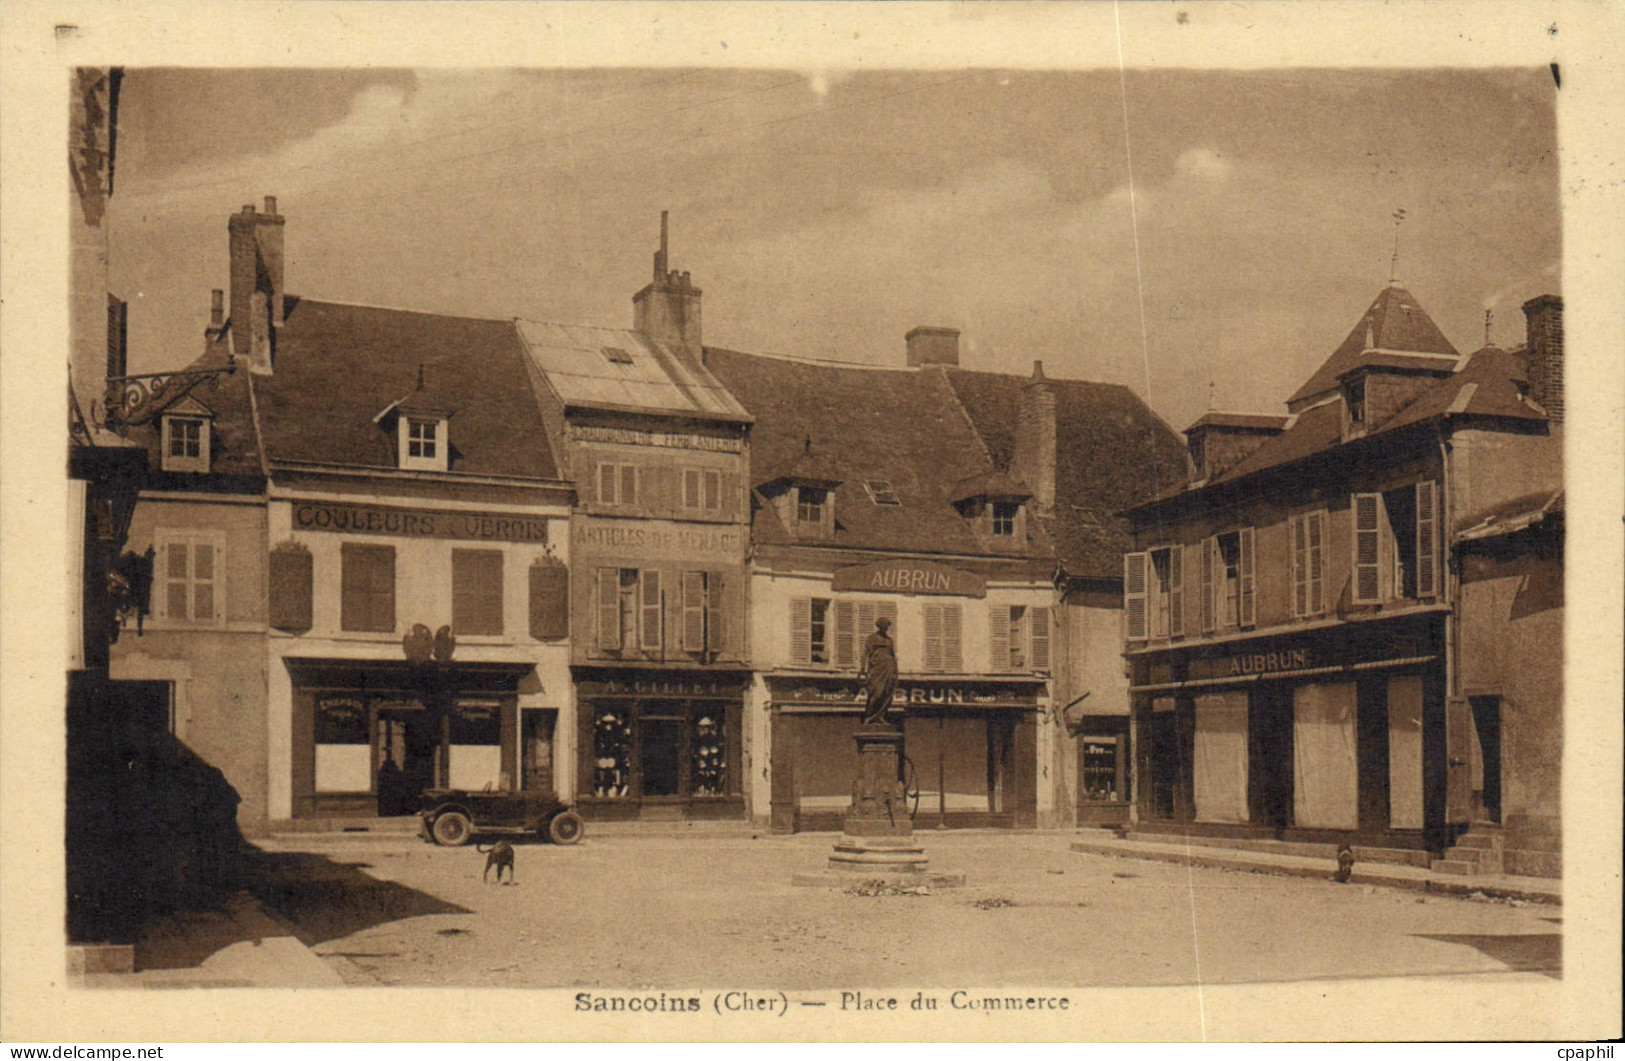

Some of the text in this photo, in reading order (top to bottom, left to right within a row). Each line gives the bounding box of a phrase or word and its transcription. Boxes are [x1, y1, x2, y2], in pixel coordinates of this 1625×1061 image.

[297, 506, 435, 535] COULEURS
[576, 525, 646, 547] ARTICLES
[871, 568, 950, 590] AUBRUN
[1229, 649, 1306, 674] AUBRUN
[854, 687, 963, 703] ABRUN
[575, 992, 701, 1012] Sancoins
[713, 992, 788, 1016] (Cher)
[840, 992, 898, 1010] Place
[911, 992, 937, 1010] du
[951, 991, 1070, 1010] Commerce
